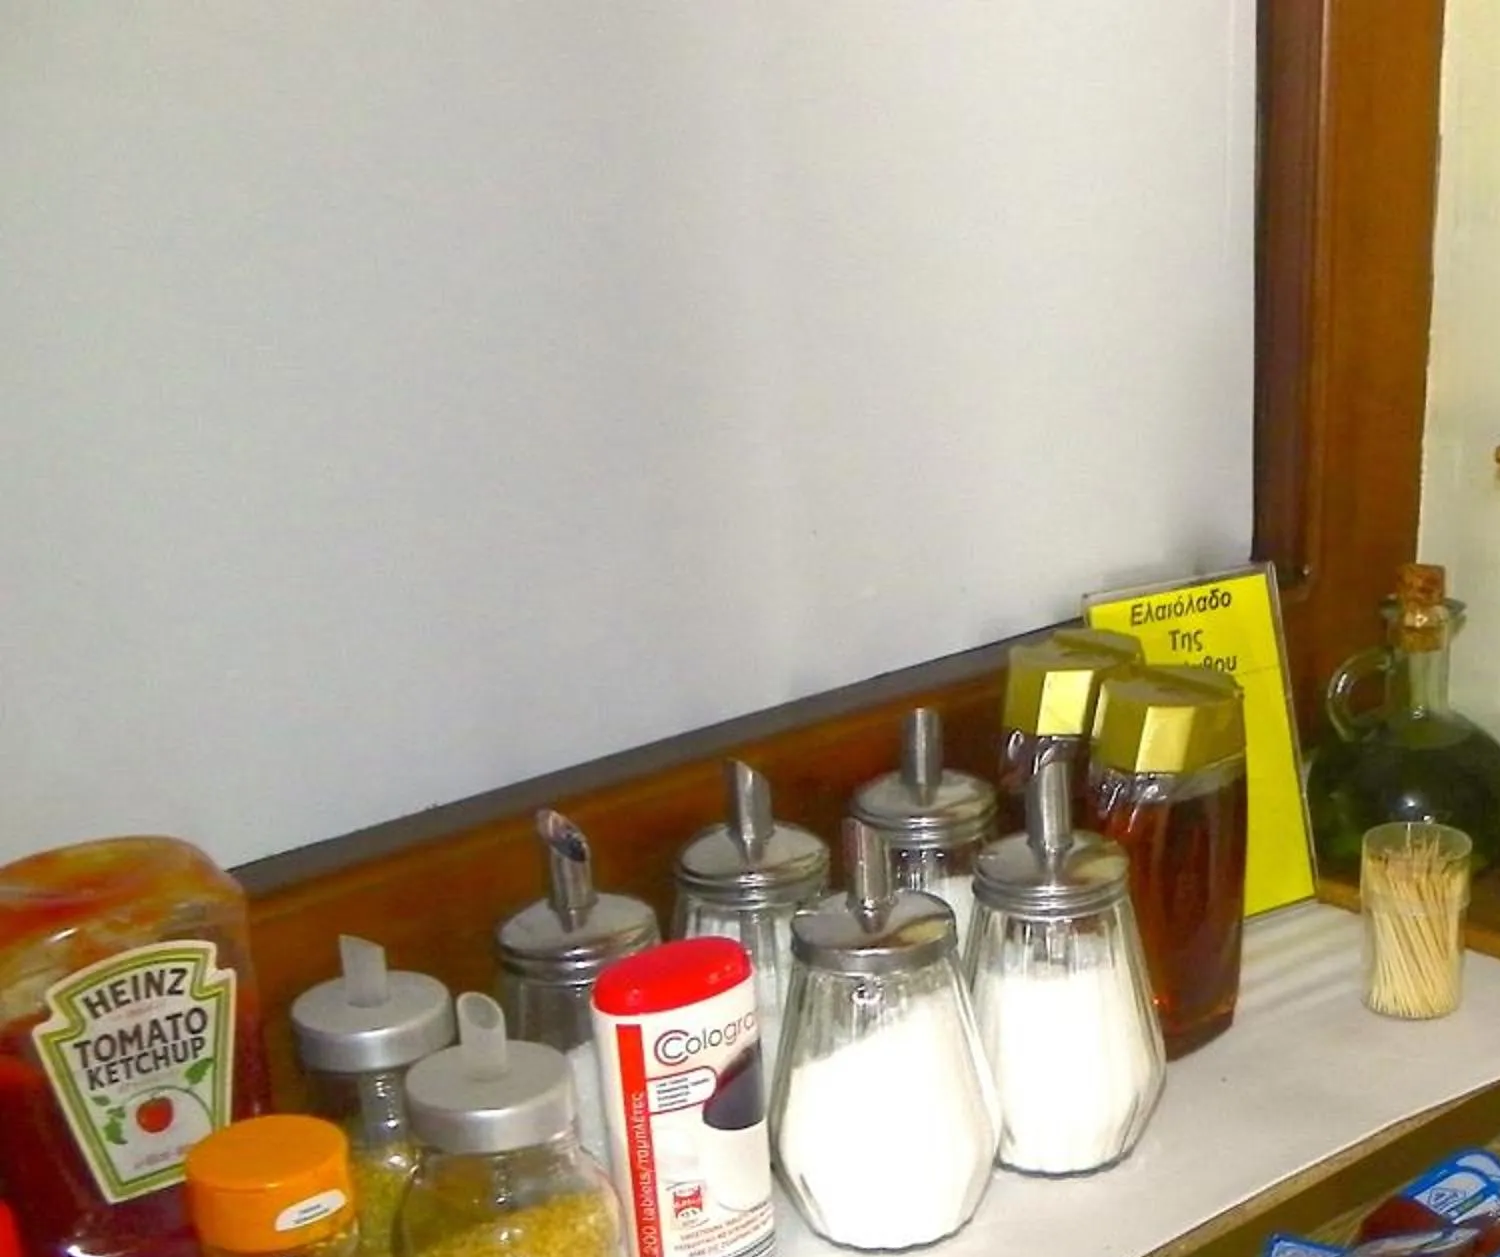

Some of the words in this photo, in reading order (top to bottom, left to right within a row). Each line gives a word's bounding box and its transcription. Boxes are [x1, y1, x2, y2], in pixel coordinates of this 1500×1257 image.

[1130, 588, 1232, 626] Ελαιόλαδο
[1168, 630, 1203, 652] Της
[82, 968, 188, 1020] HEINZ
[73, 1007, 208, 1069] TOMATO
[87, 1037, 206, 1091] KETCHUP
